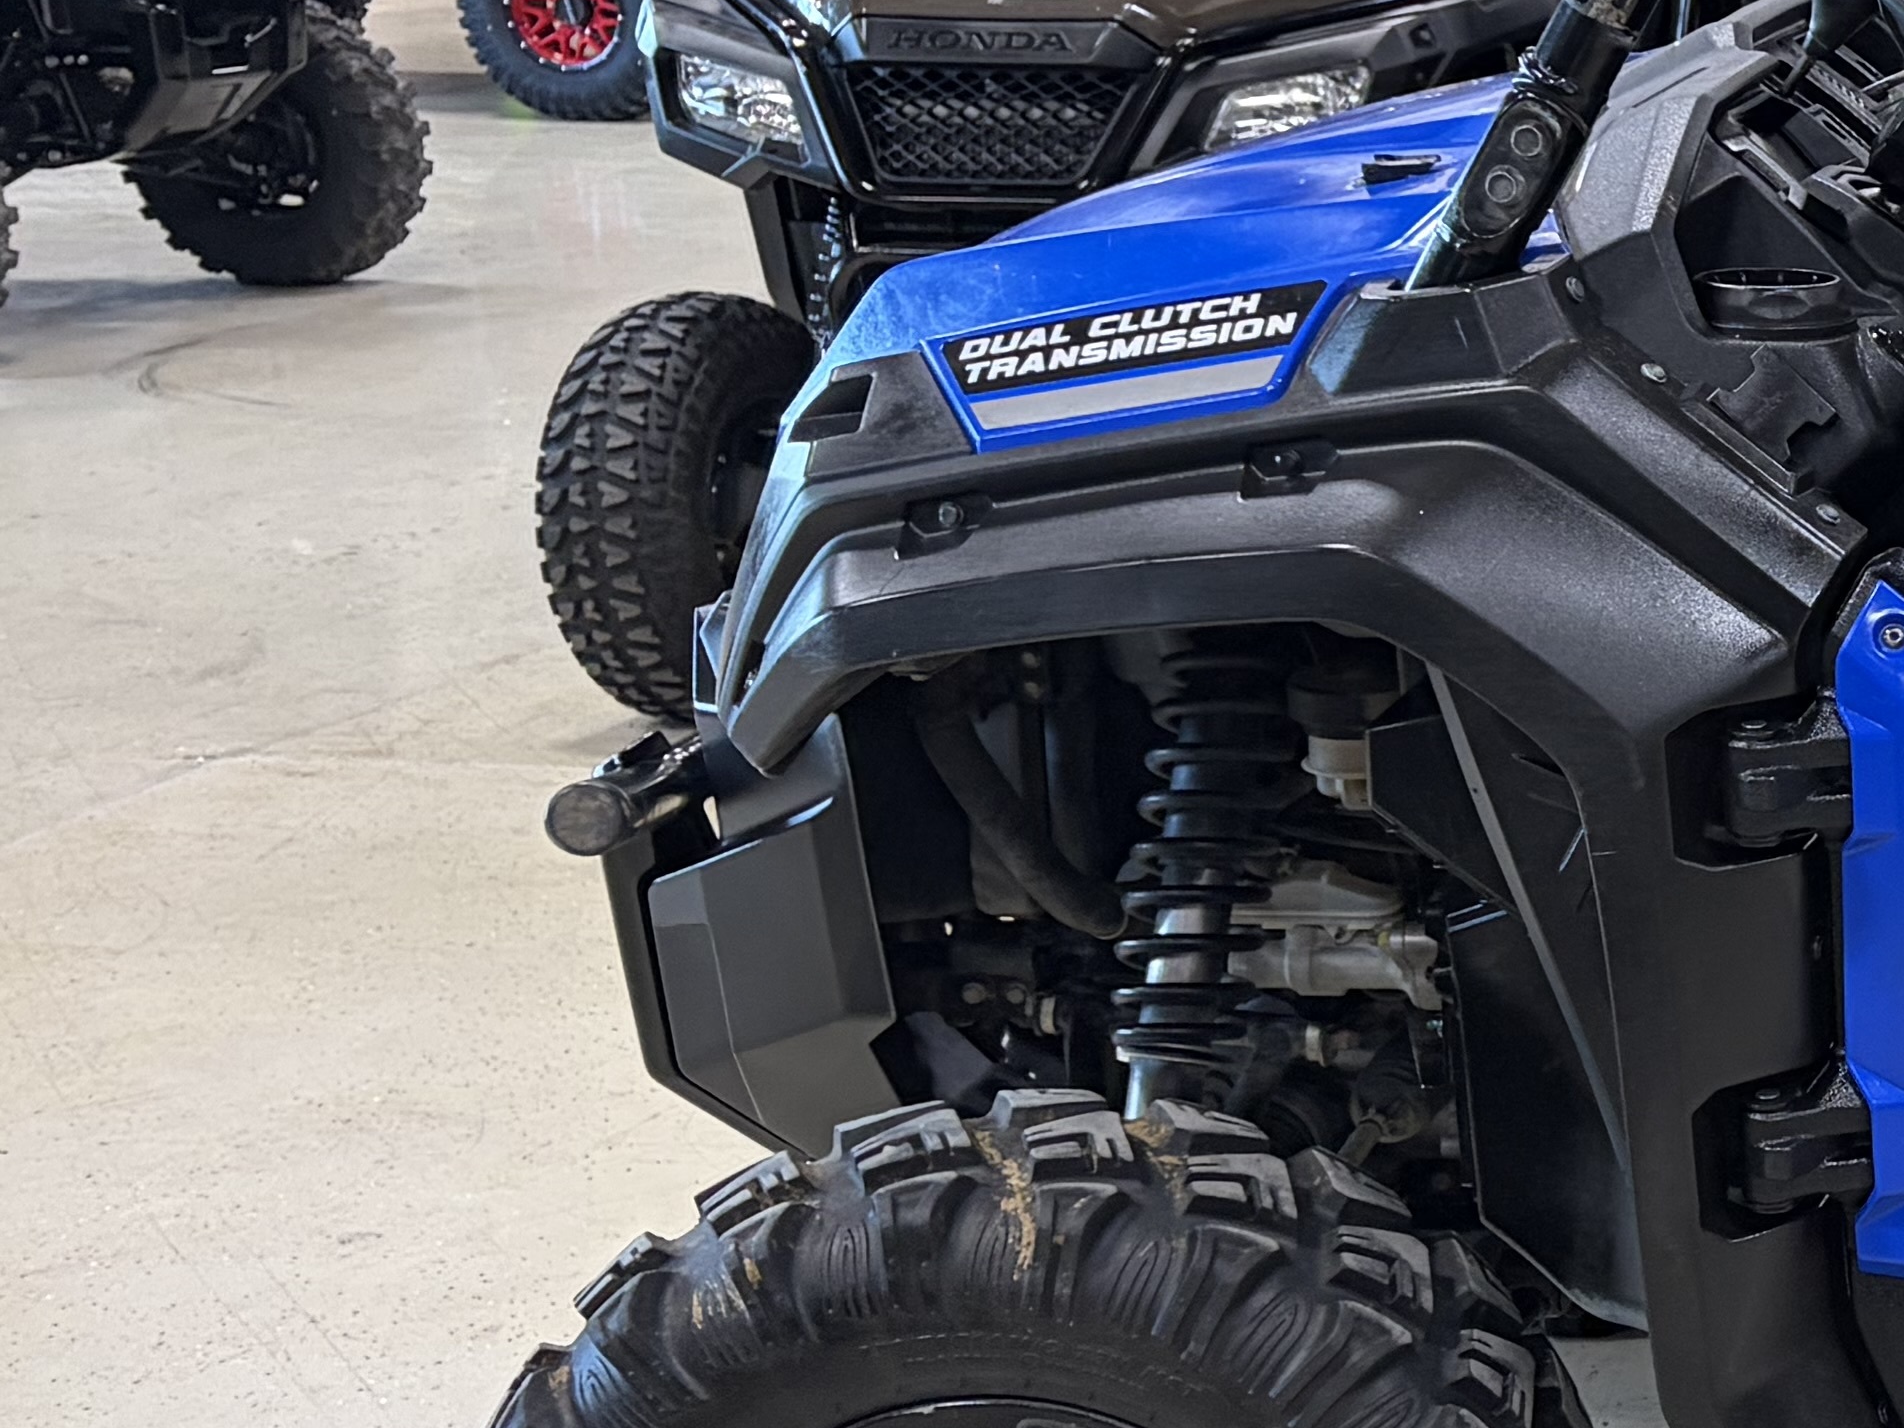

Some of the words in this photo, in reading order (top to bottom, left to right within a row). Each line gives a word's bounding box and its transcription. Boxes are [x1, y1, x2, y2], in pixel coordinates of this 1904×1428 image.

[886, 28, 1076, 53] HONDA
[959, 323, 1074, 361] DUAL
[1088, 292, 1262, 339] CLUTCH
[964, 311, 1298, 385] TRANSMISSION
